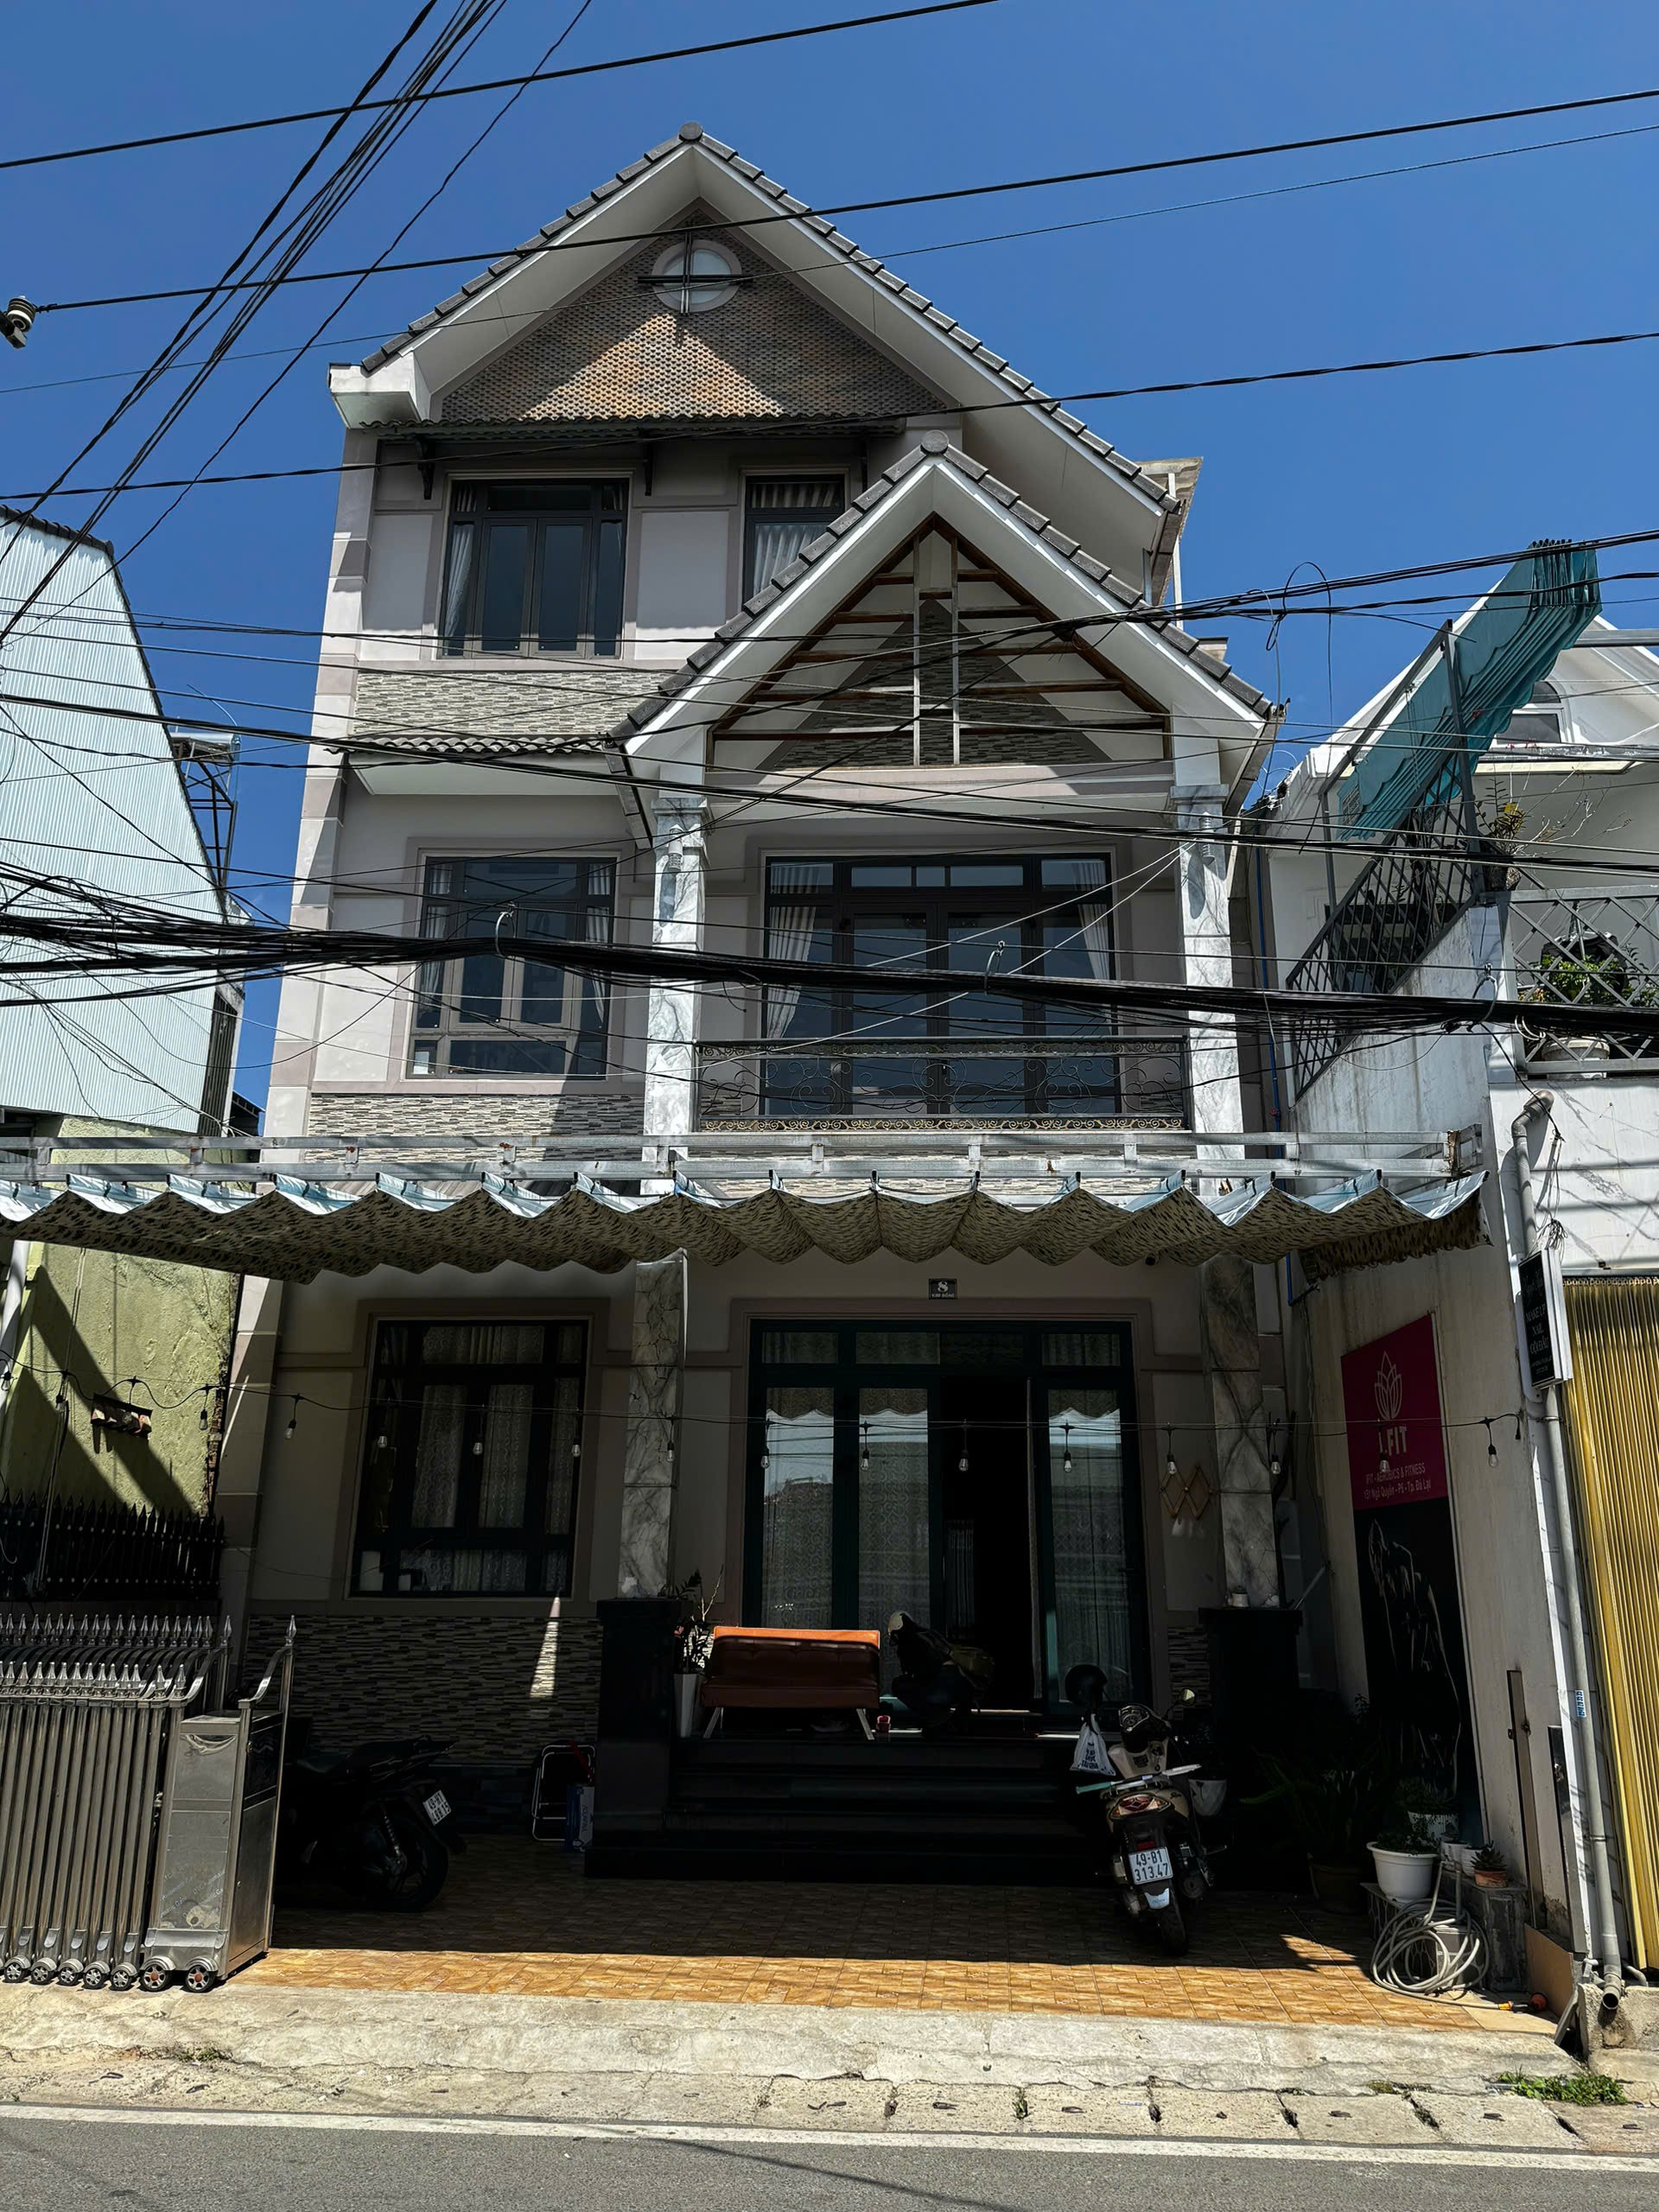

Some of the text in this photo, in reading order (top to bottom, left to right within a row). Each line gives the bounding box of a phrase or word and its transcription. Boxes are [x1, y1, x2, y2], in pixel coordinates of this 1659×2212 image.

[938, 1281, 948, 1293] 8
[1136, 1850, 1162, 1866] 49-B1
[1135, 1863, 1168, 1881] 313.47
